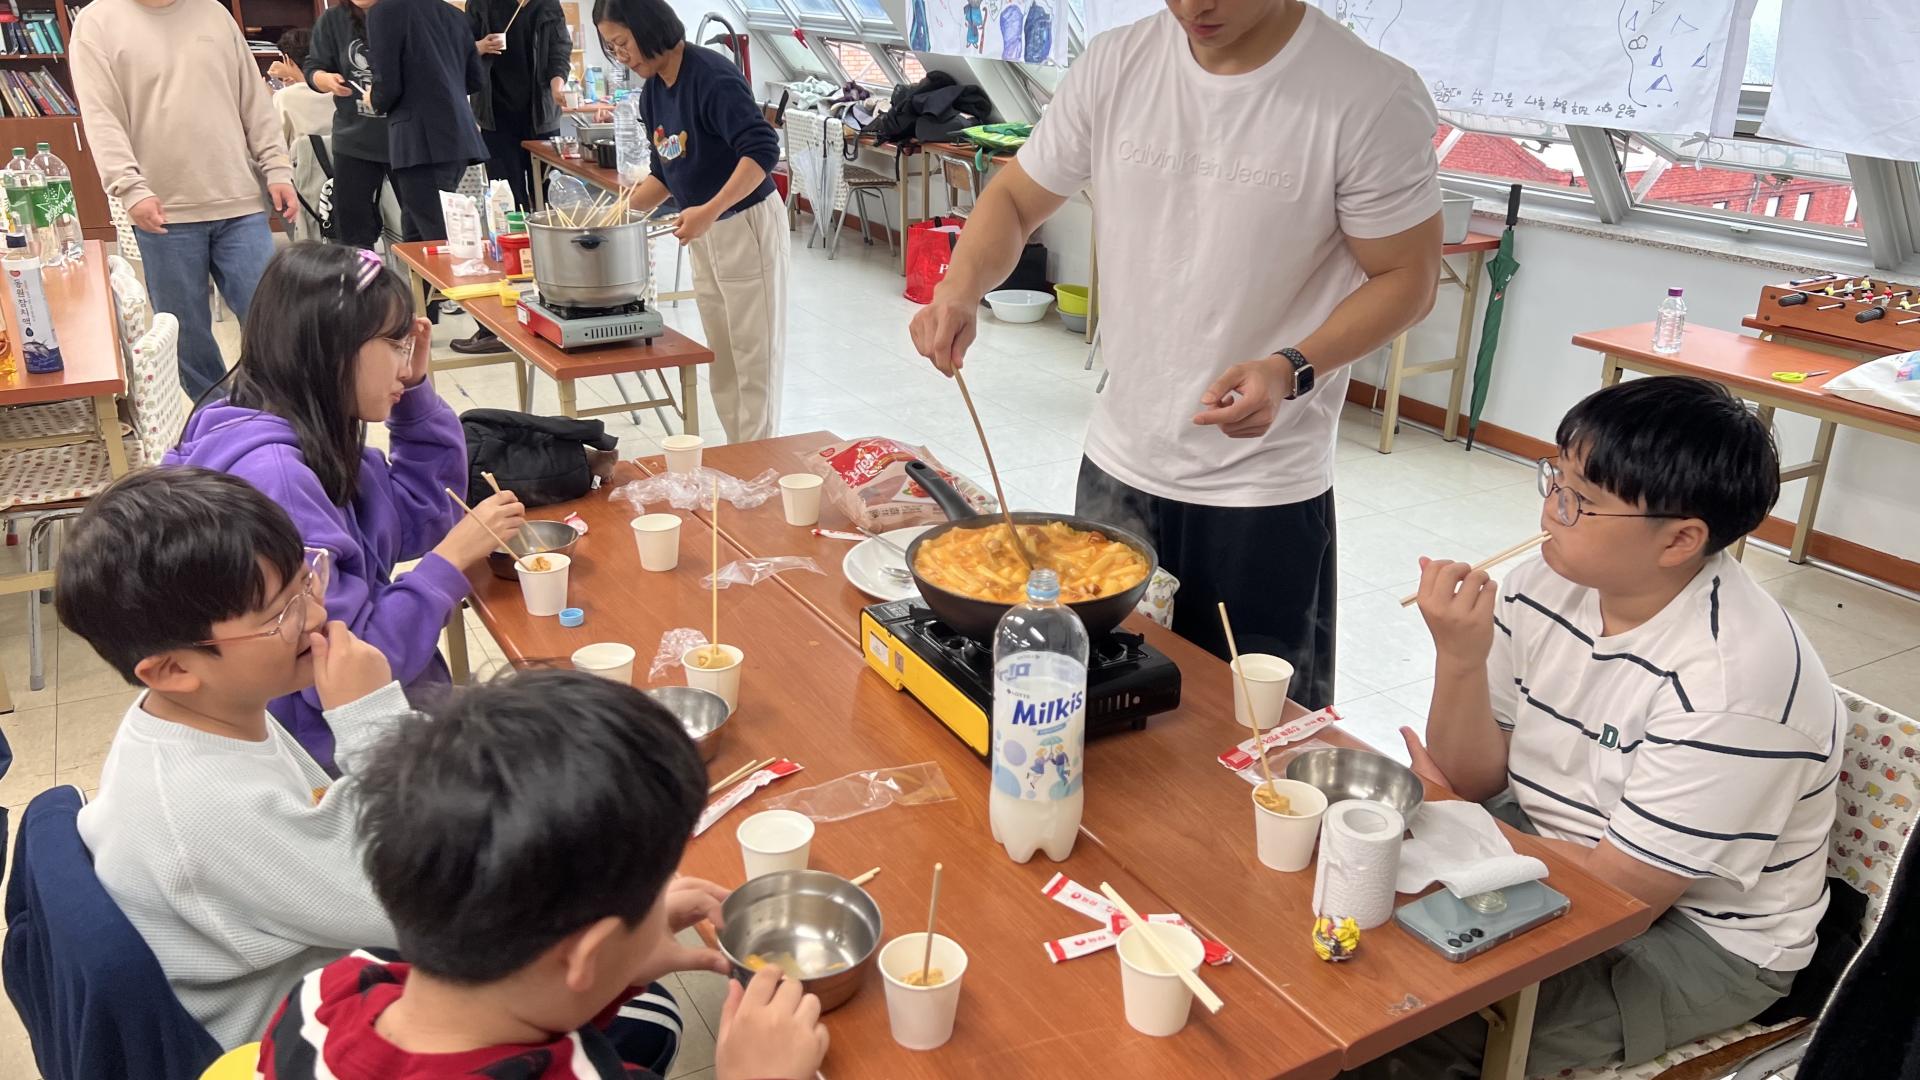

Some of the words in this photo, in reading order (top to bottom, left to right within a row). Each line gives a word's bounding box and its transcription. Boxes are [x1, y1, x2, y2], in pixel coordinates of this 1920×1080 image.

[1118, 140, 1178, 171] Calvin
[1225, 159, 1296, 190] Jeans
[1011, 690, 1083, 727] Milkis
[1598, 722, 1619, 749] D
